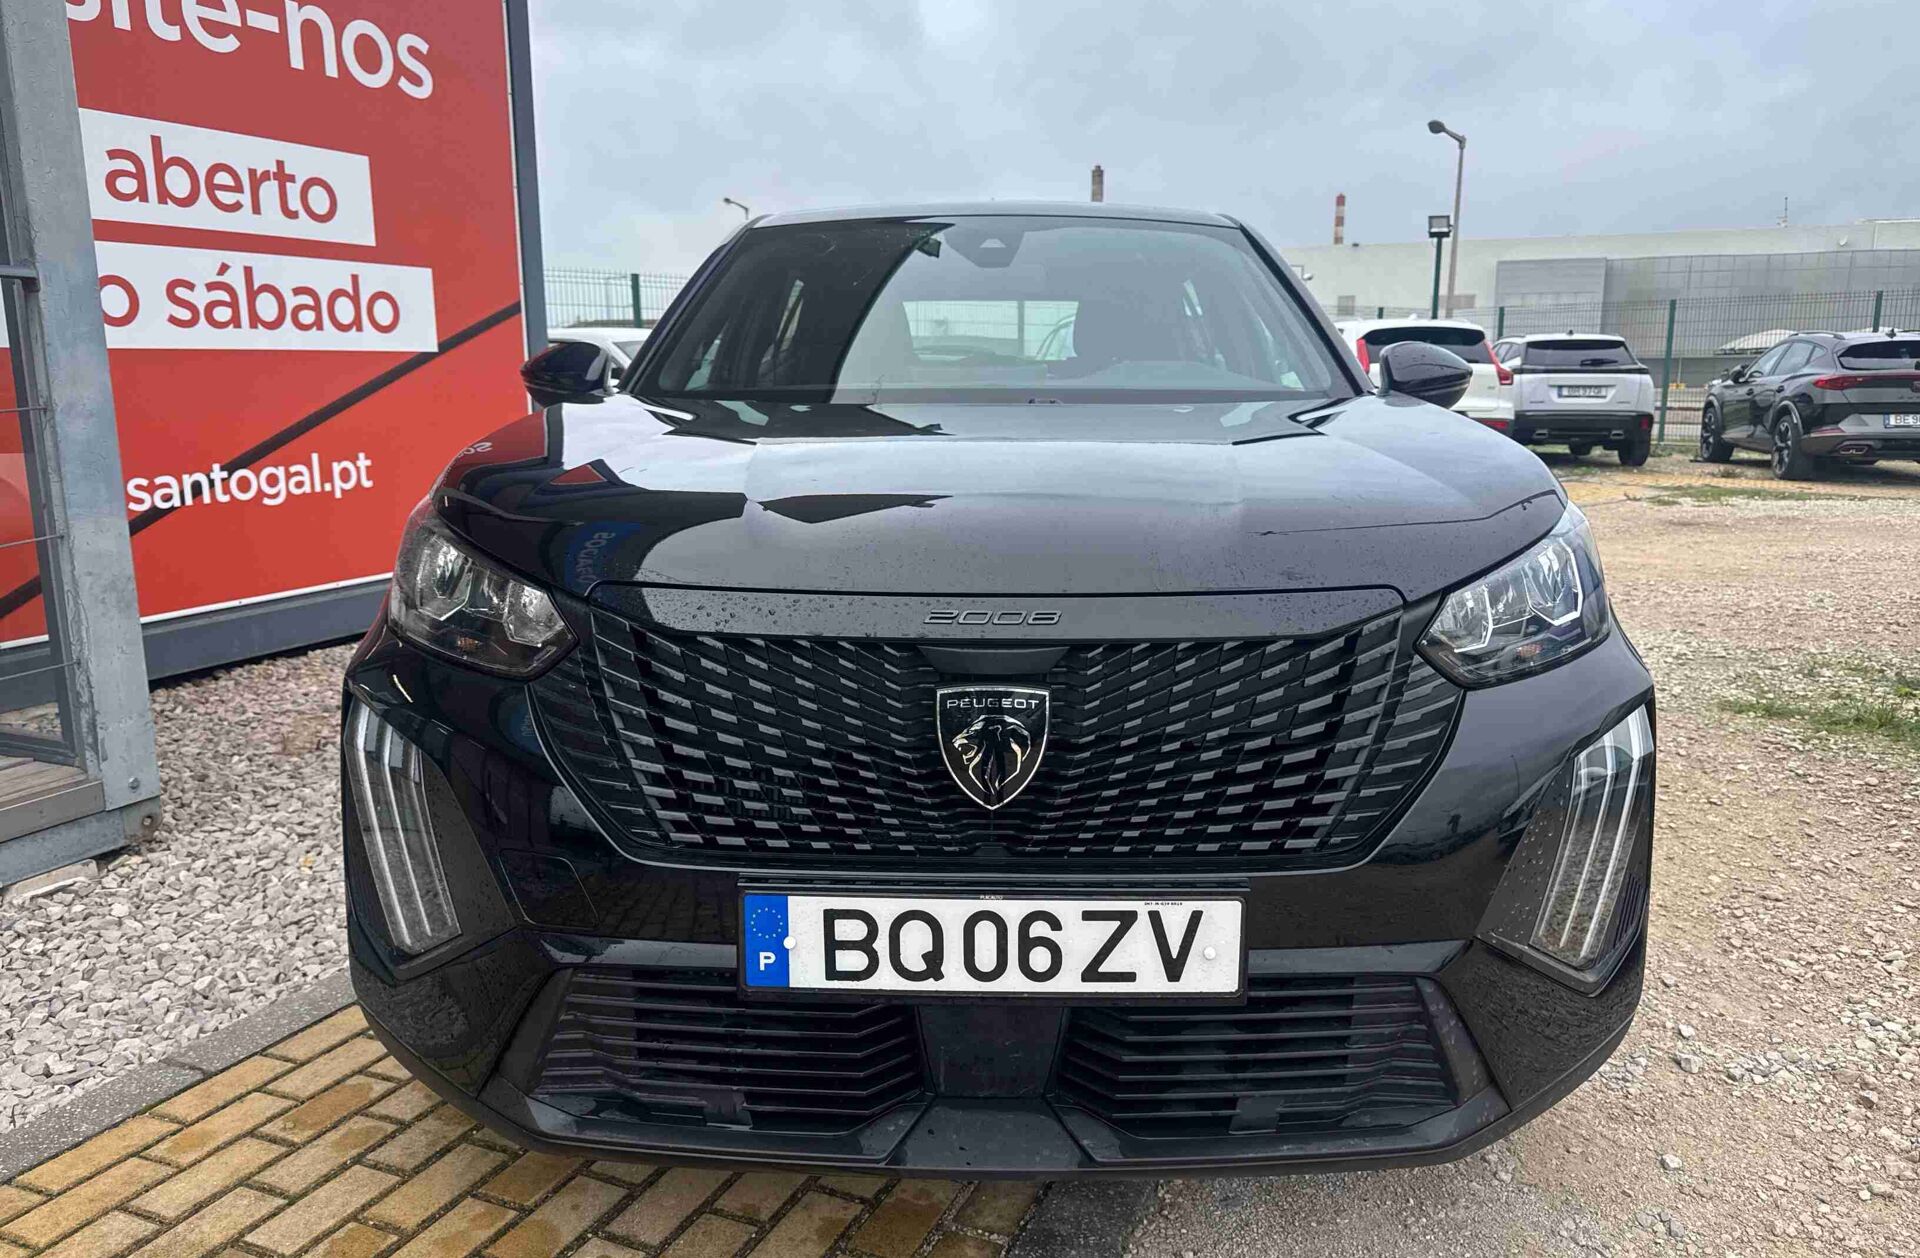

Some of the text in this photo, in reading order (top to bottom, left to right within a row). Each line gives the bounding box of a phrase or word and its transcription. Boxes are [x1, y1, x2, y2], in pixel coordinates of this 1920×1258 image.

[104, 134, 338, 223] aberto
[165, 261, 400, 334] sábado
[1895, 414, 1920, 425] BE9
[126, 452, 374, 512] santogal.pt
[923, 609, 1062, 625] 2008
[946, 698, 1040, 709] PEUGEOT
[759, 951, 777, 971] P
